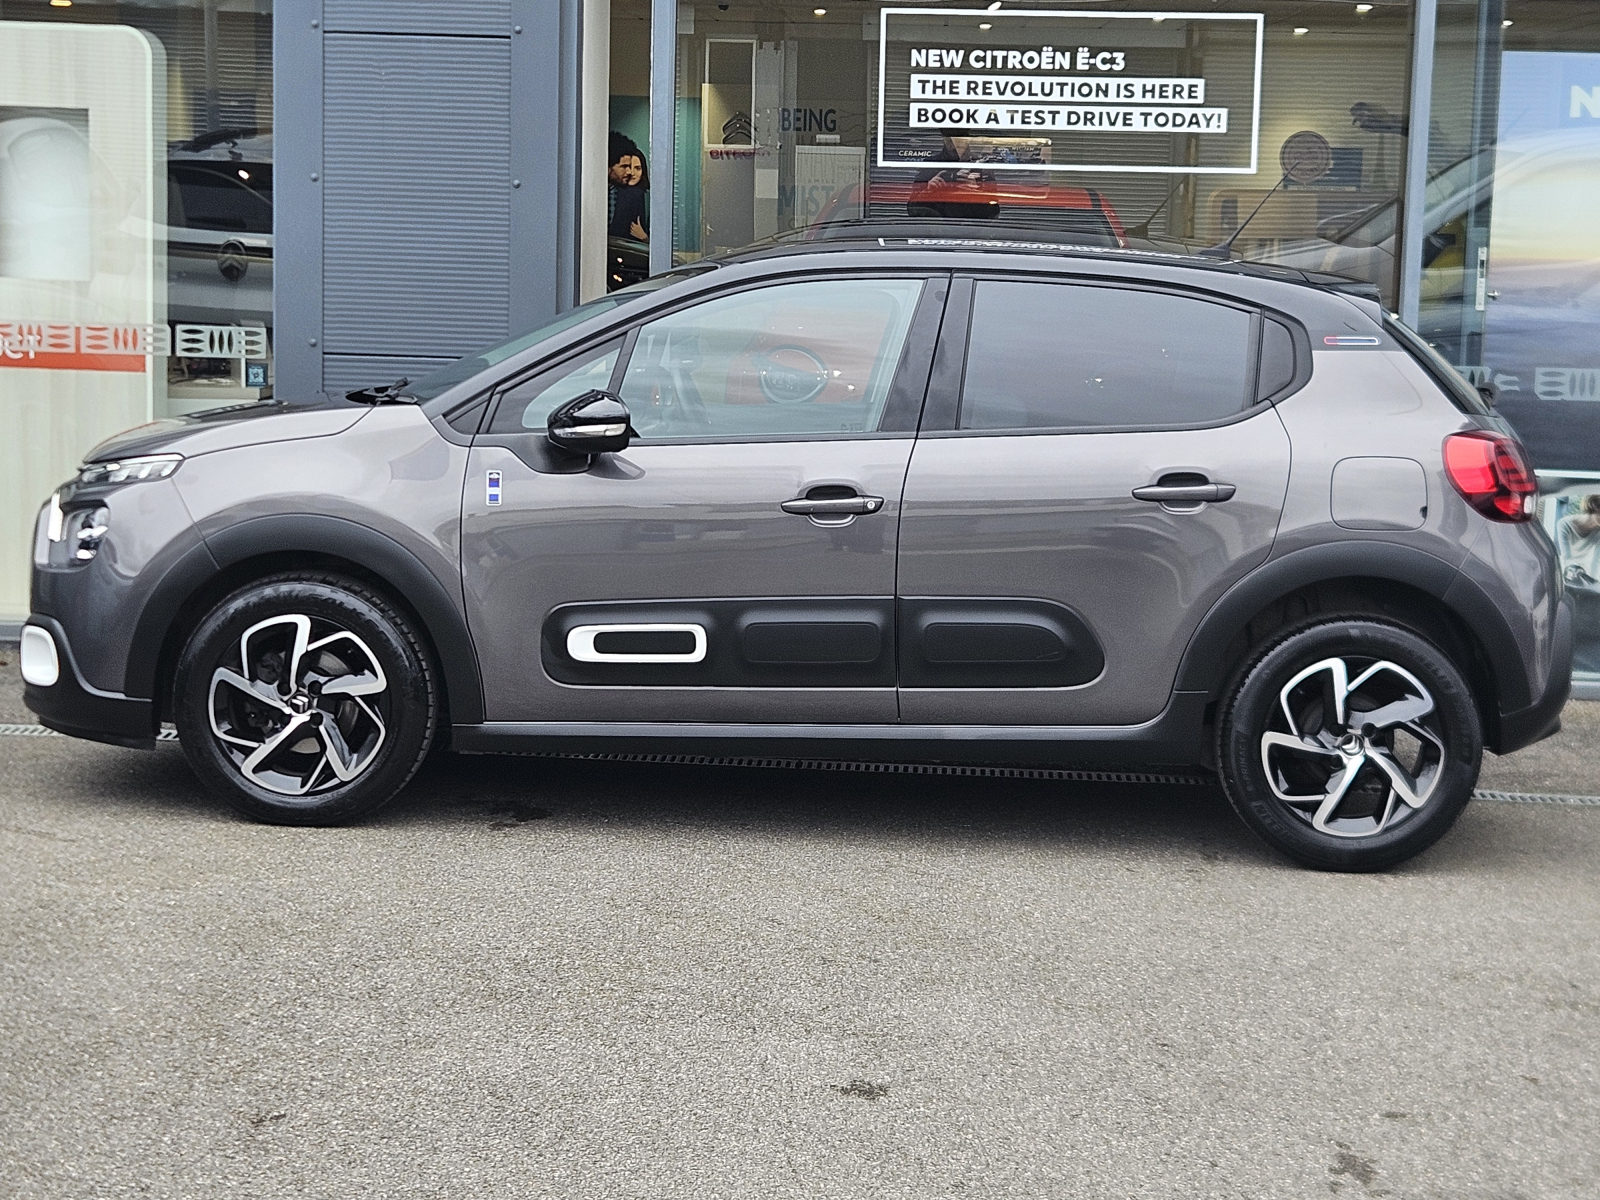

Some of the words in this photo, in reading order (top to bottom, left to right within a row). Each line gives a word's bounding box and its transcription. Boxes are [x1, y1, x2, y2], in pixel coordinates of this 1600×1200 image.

[910, 49, 964, 68] NEW
[969, 47, 1071, 70] CITROËN
[1076, 47, 1125, 71] Ë-C3
[917, 80, 960, 96] THE
[966, 81, 1108, 98] REVOLUTION
[1115, 83, 1136, 99] IS
[1141, 84, 1199, 100] HERE
[782, 108, 837, 133] BEING
[917, 108, 979, 124] BOOK
[986, 109, 1000, 125] A
[1006, 109, 1059, 125] TEST
[1066, 111, 1133, 127] DRIVE
[1139, 112, 1223, 129] TODAY!
